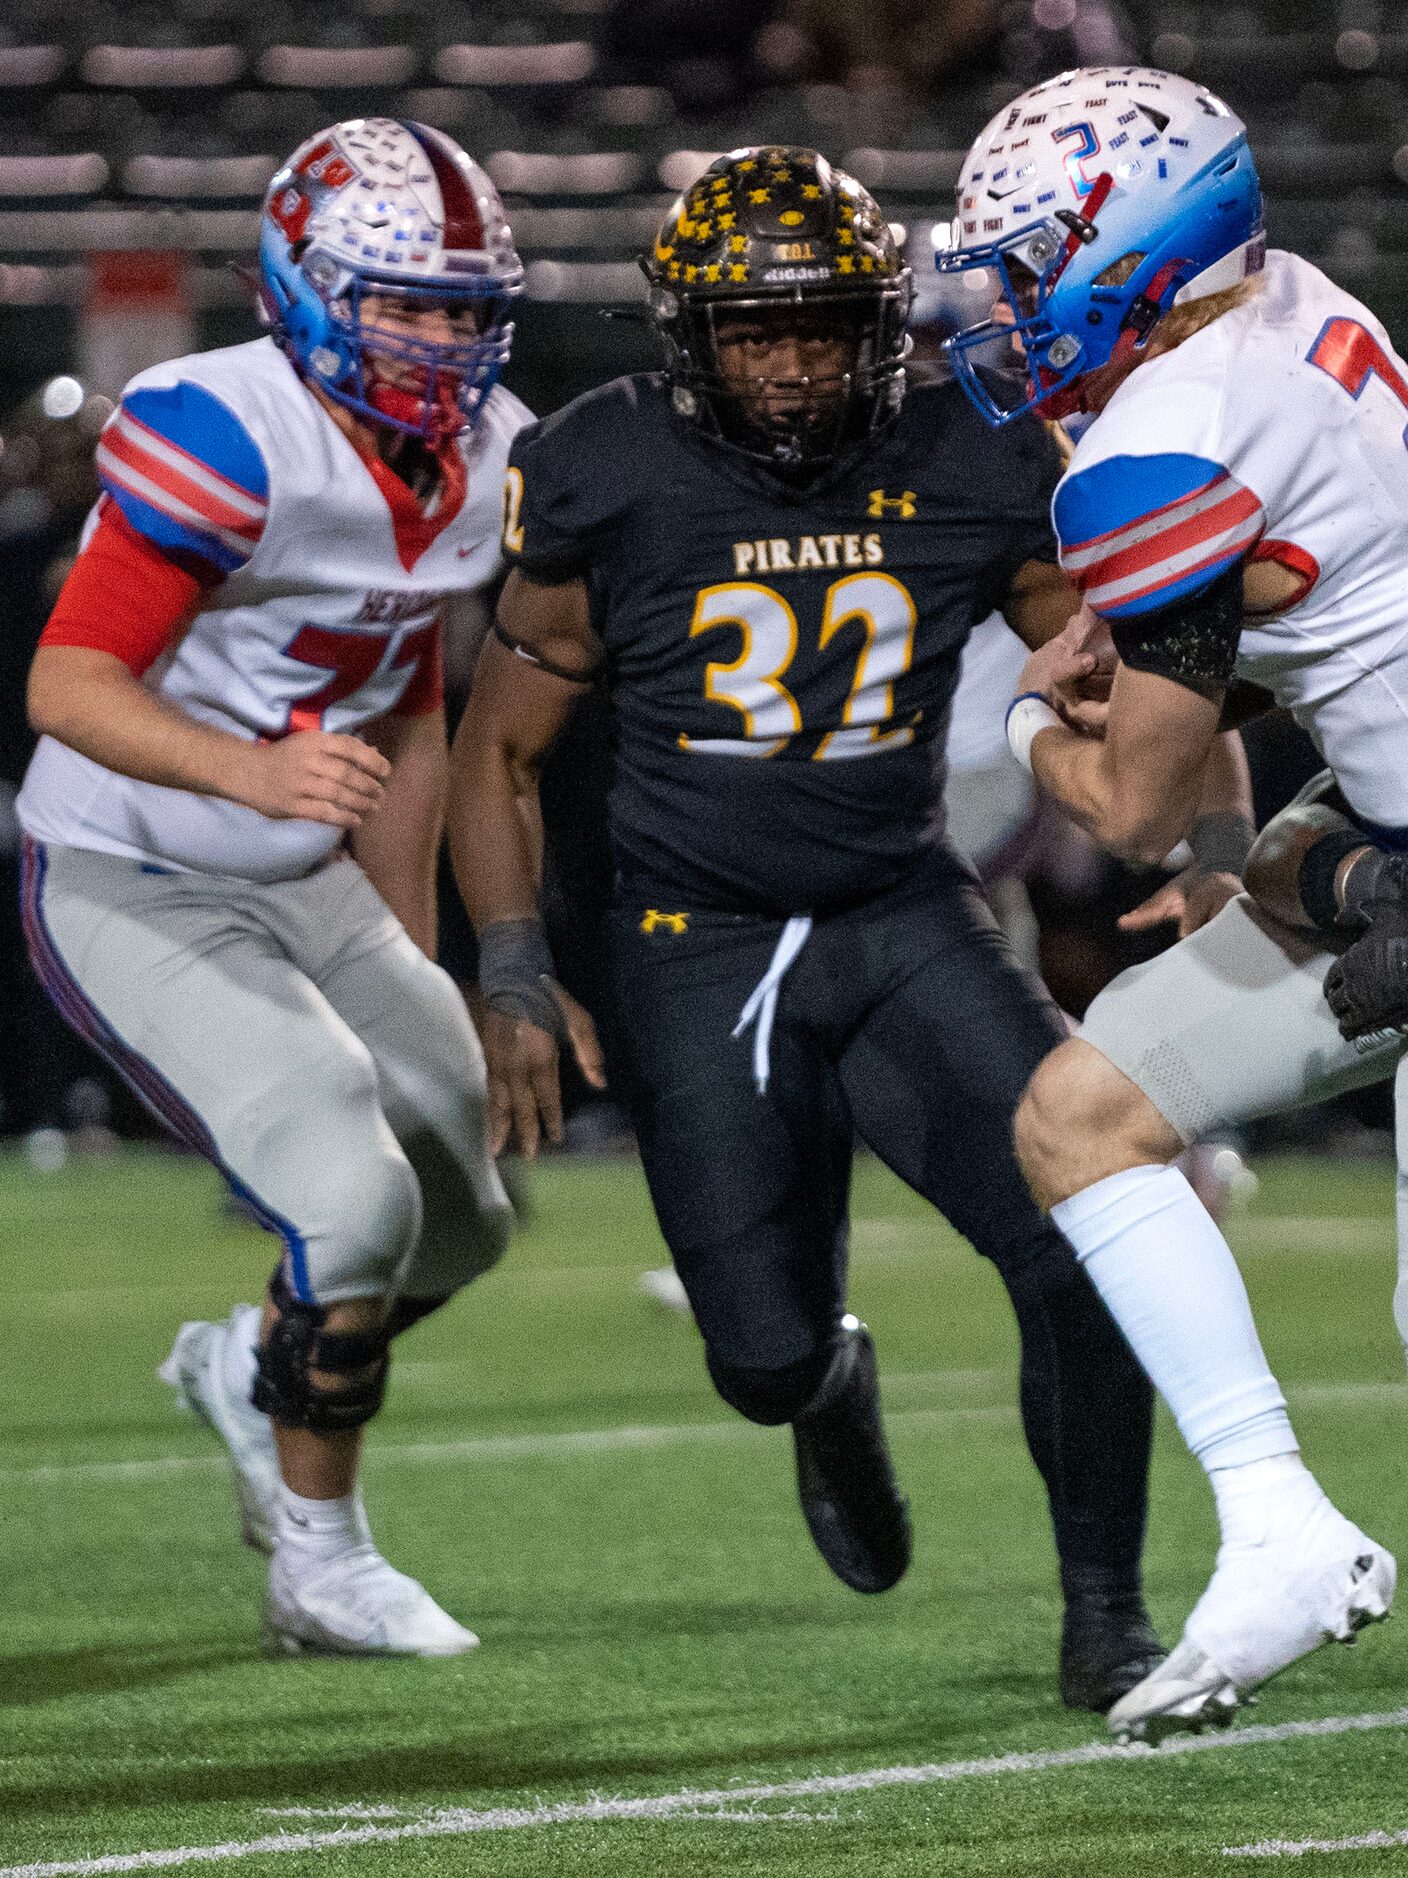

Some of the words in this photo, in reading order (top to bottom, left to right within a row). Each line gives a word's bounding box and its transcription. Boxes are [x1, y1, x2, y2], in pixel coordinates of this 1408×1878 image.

[1085, 98, 1108, 108] FEAST
[1022, 113, 1048, 127] FIGHT
[1117, 109, 1138, 125] FEAST
[1108, 131, 1130, 150] FEAST
[1050, 118, 1117, 202] 2
[983, 217, 1003, 232] FIGHT
[732, 533, 884, 576] PIRATES
[678, 571, 923, 762] 32
